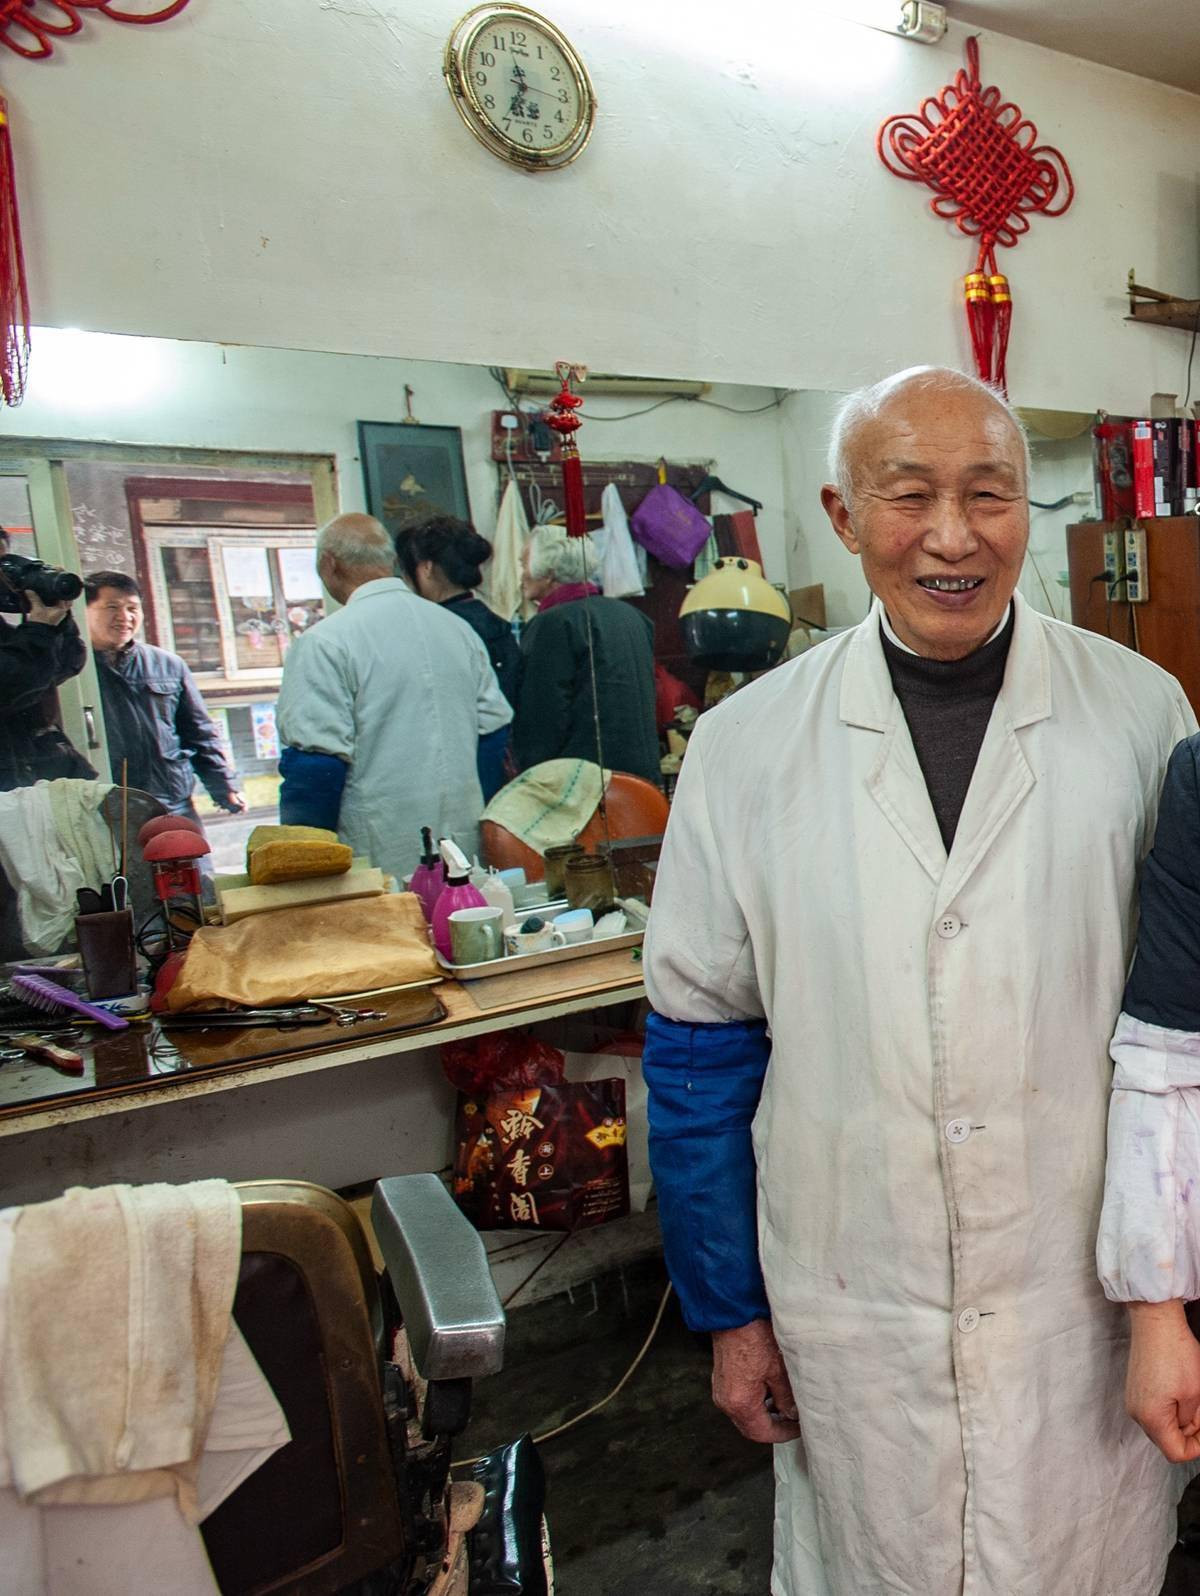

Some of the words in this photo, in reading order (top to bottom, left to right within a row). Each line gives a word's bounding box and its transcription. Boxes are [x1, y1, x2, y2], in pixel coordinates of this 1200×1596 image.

[493, 35, 506, 51] 11
[510, 31, 527, 47] 12
[480, 51, 496, 67] 10
[537, 46, 543, 60] 1
[476, 71, 487, 86] 9
[550, 67, 560, 82] 2
[484, 94, 496, 110] 8
[558, 89, 569, 104] 3
[554, 110, 565, 123] 4
[502, 117, 512, 132] 7
[543, 125, 553, 139] 5
[522, 128, 534, 143] 6
